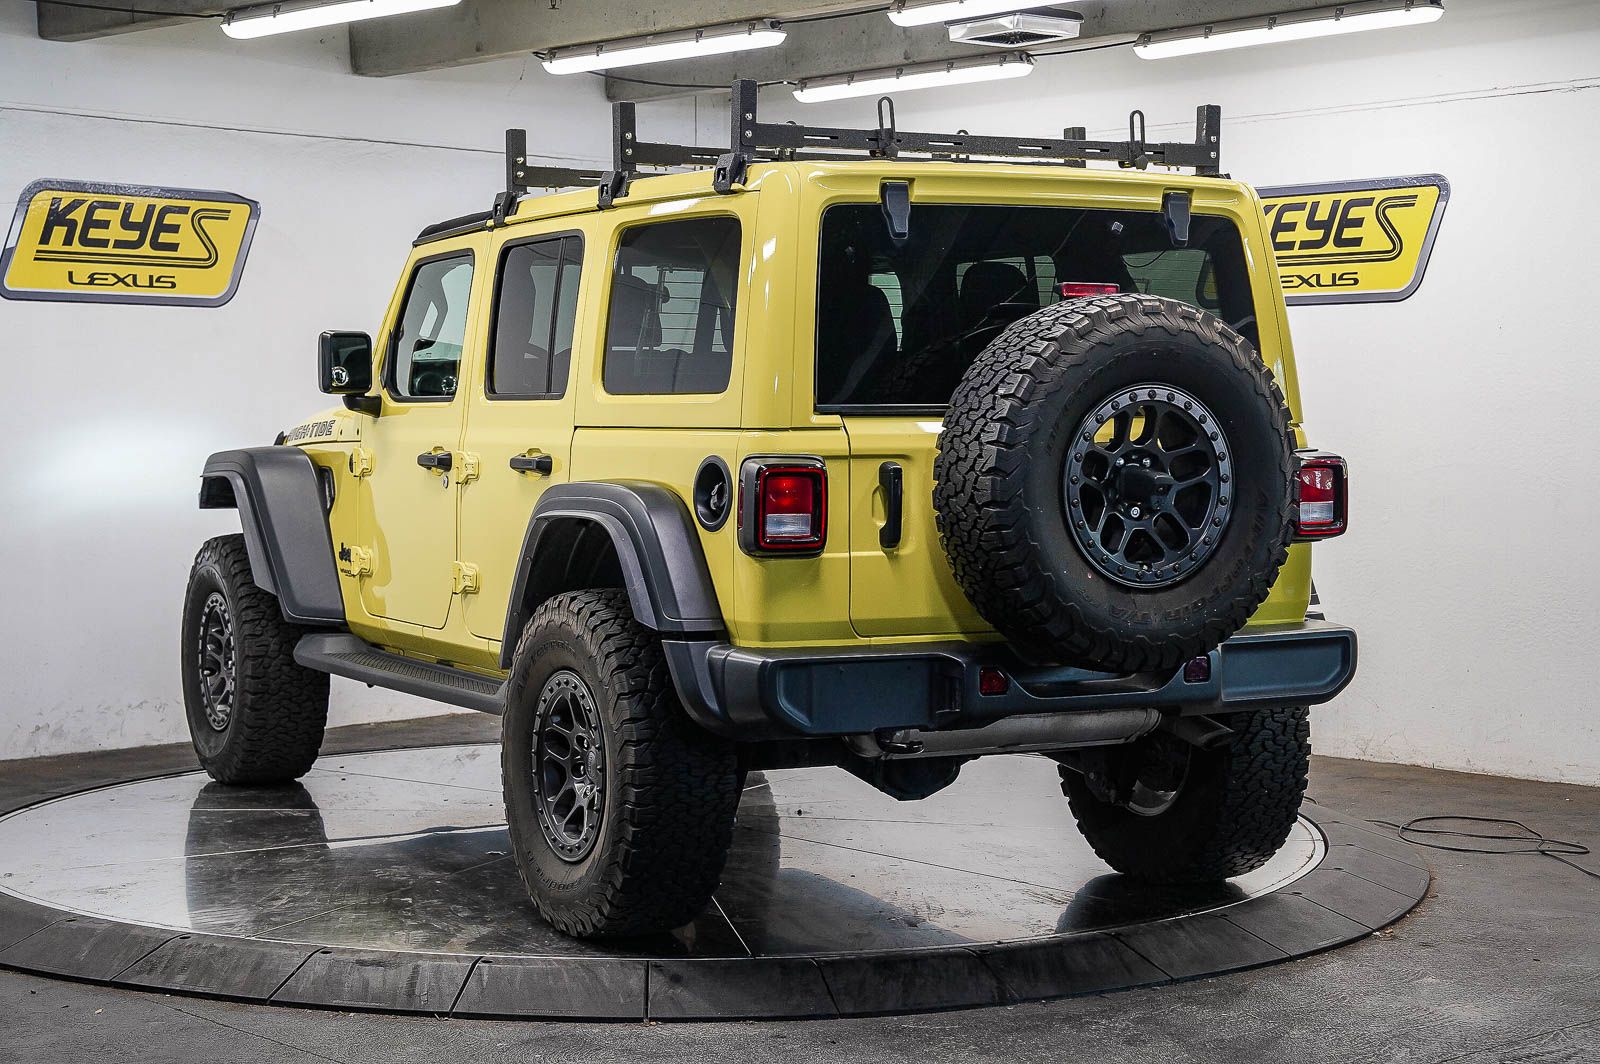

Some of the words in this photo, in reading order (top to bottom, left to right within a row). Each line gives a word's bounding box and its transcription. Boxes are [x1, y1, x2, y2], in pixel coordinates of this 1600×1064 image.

[33, 196, 232, 269] KEYES
[67, 270, 177, 289] LEXUS
[1280, 271, 1360, 289] EXUS
